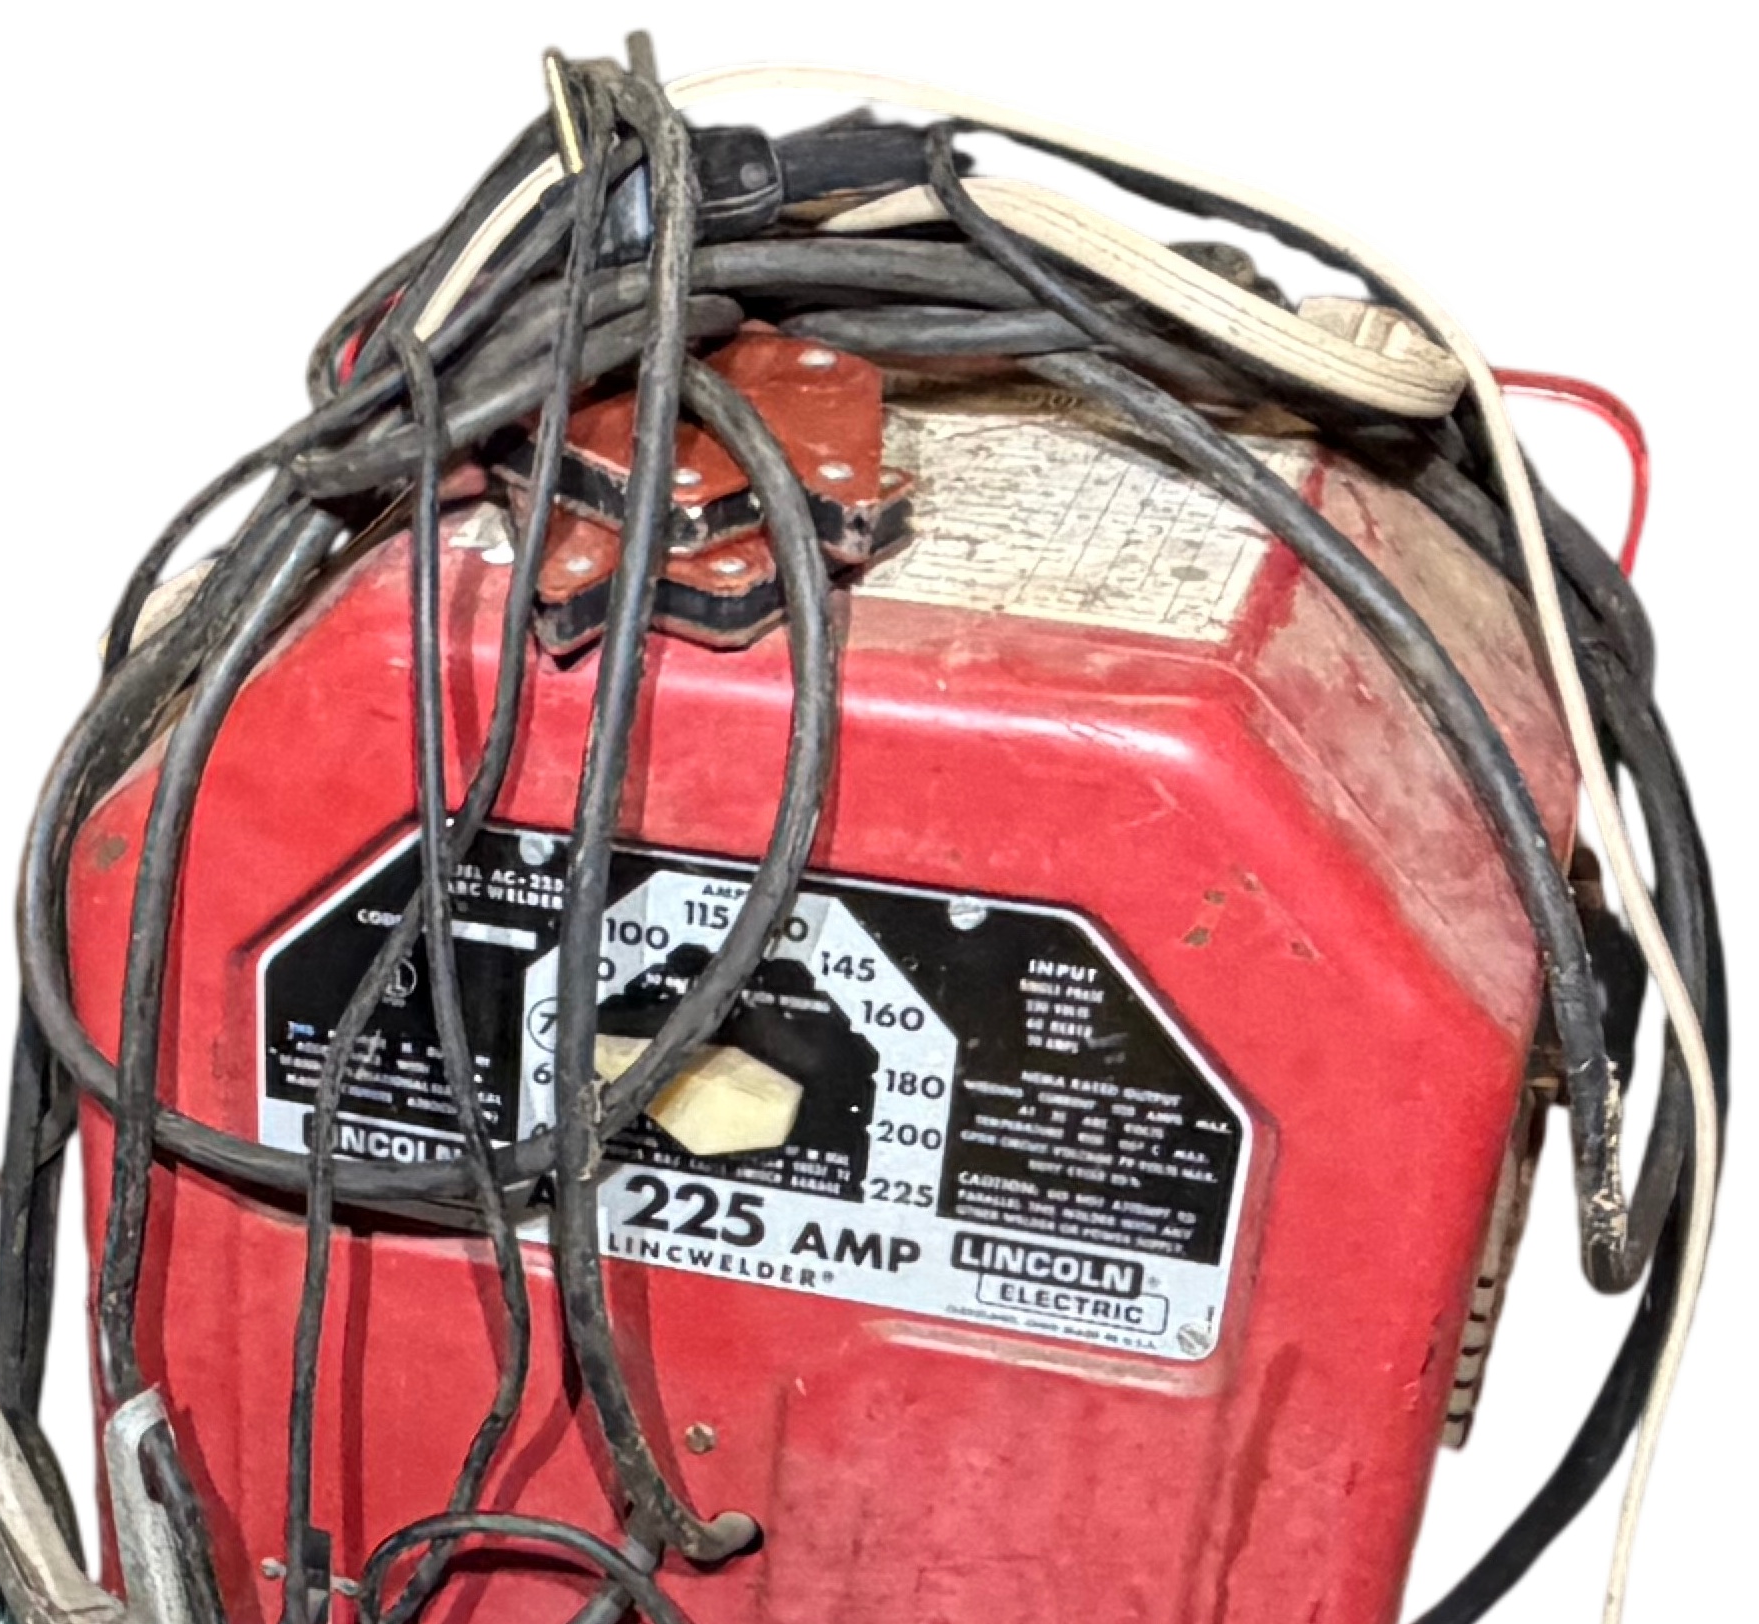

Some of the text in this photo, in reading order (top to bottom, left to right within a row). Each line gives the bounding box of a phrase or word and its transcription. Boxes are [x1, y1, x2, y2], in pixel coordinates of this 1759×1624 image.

[487, 884, 564, 911] WELDER
[684, 900, 729, 930] 115
[606, 917, 670, 950] 100
[821, 951, 876, 982] 145
[1028, 959, 1098, 983] INPUT
[862, 999, 925, 1031] 160
[885, 1069, 946, 1100] 180
[340, 1124, 464, 1163] NCOLN
[877, 1119, 942, 1150] 200
[869, 1177, 934, 1208] 225
[622, 1173, 765, 1248] 225
[790, 1221, 921, 1273] AMP
[959, 1237, 1135, 1294] LINCOLN
[1000, 1282, 1144, 1324] ELECTRIC
